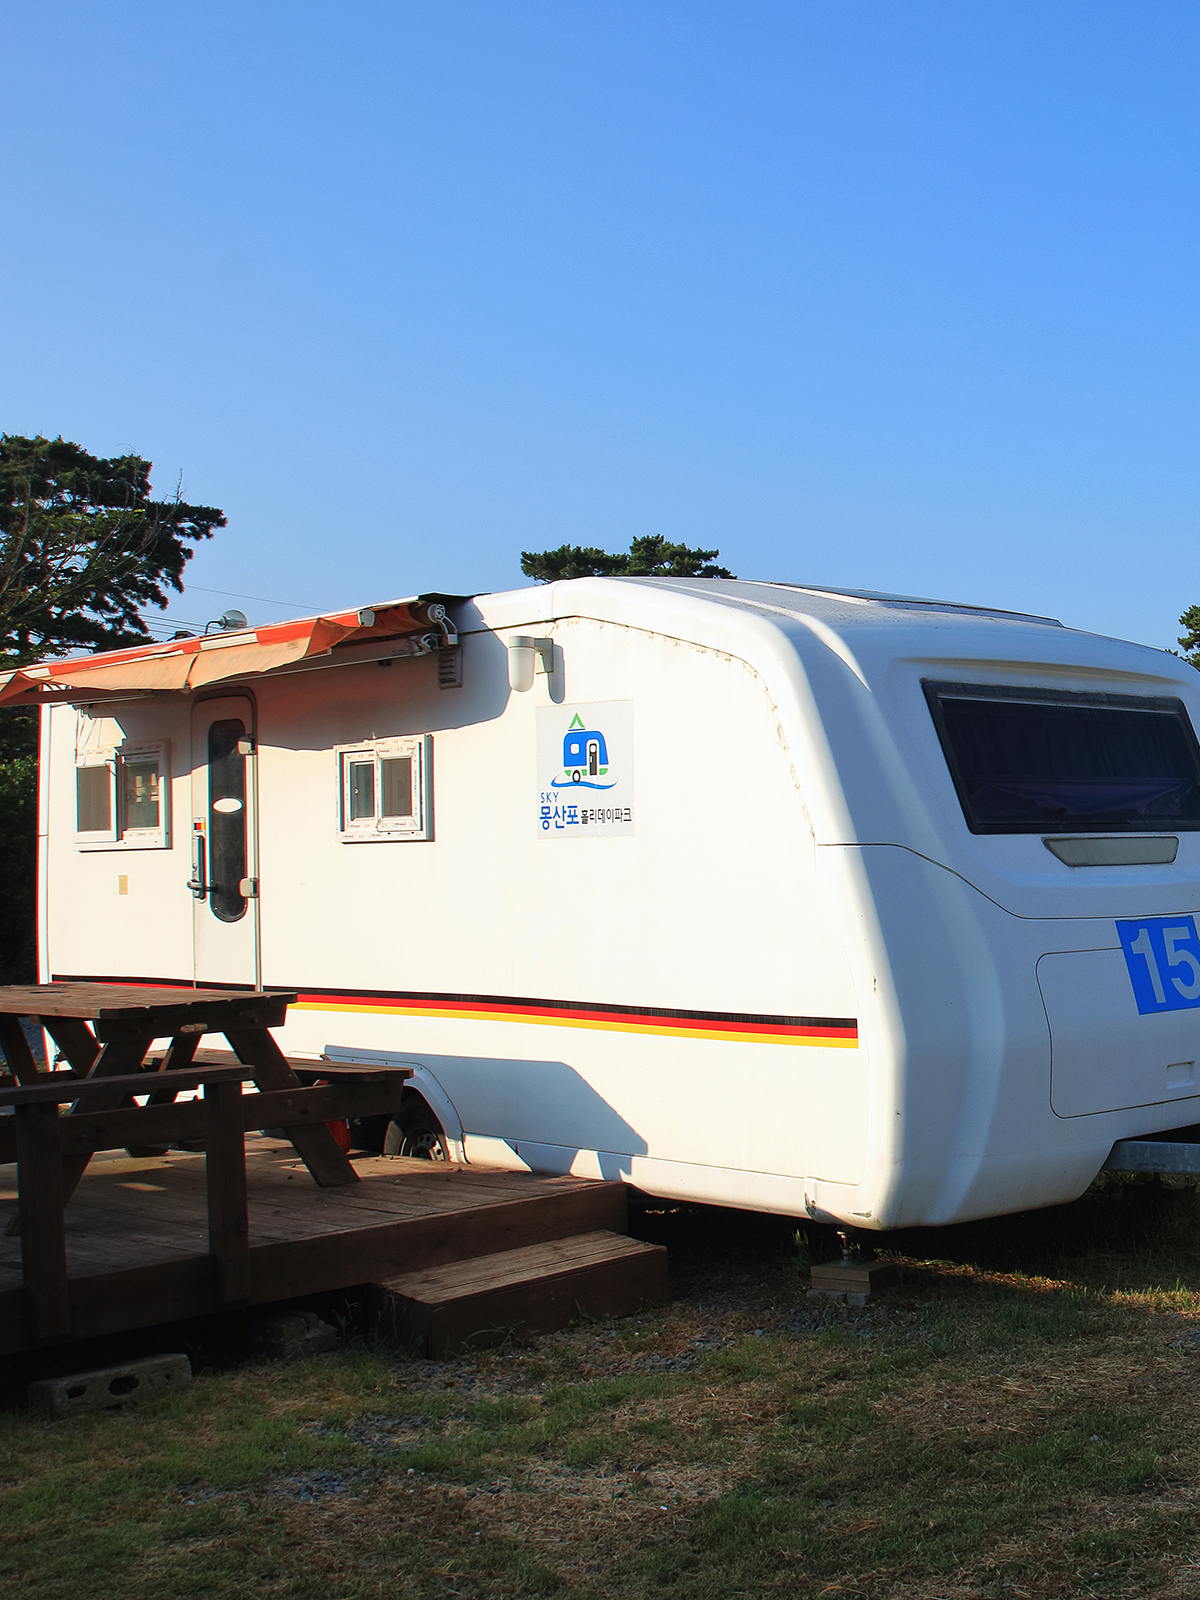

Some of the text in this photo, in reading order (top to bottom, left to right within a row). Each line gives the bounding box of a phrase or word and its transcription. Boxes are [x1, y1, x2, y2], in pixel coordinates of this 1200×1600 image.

[540, 792, 559, 803] SKY
[540, 805, 632, 830] 몽산포 홀리데이파크
